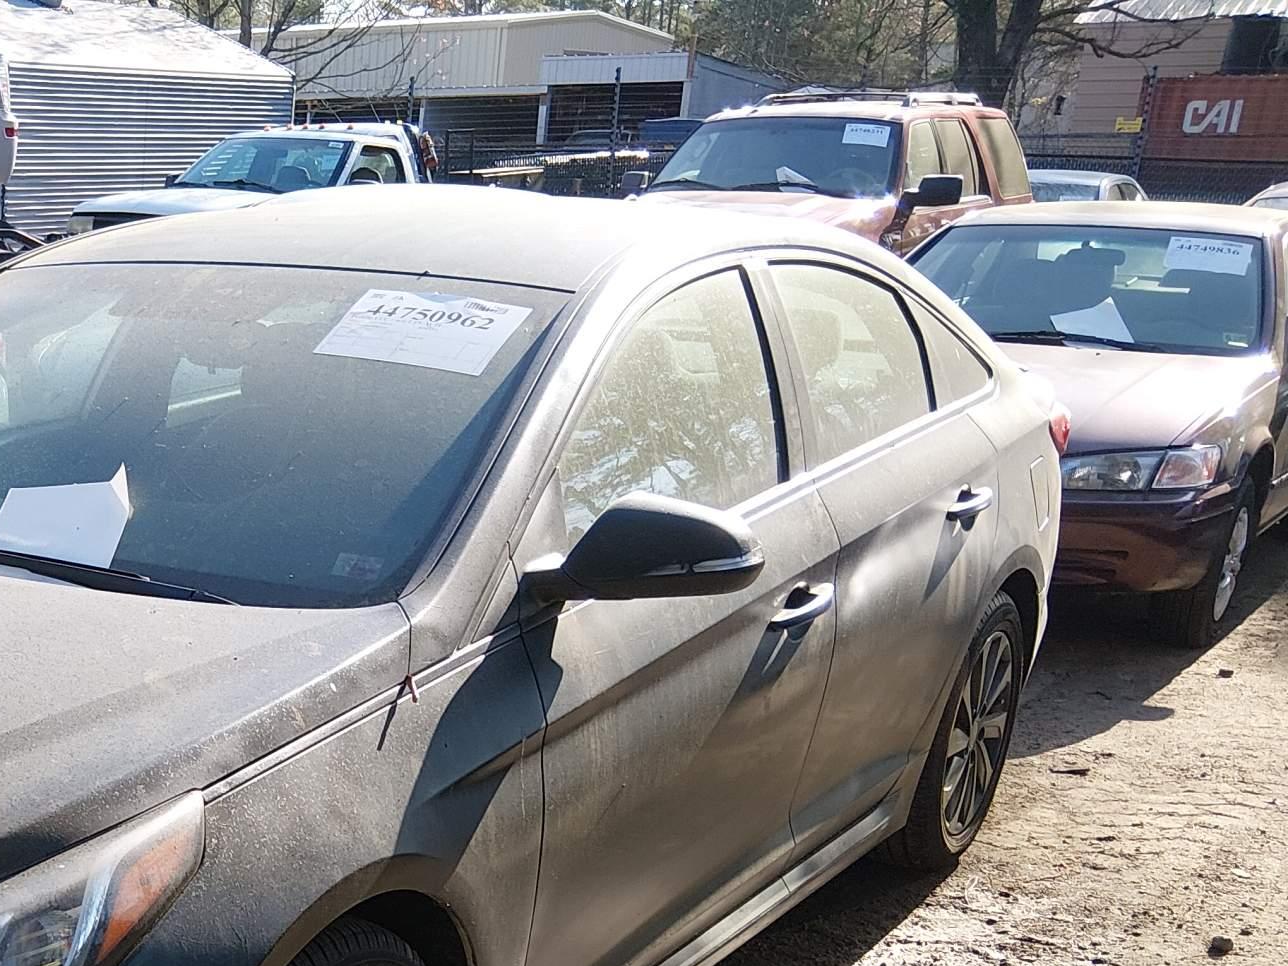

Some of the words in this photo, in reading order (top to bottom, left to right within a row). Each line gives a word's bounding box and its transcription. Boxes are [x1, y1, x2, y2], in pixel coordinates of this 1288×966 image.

[1182, 99, 1244, 134] CAI
[1176, 243, 1240, 256] 44749836
[367, 303, 496, 331] 44750962
